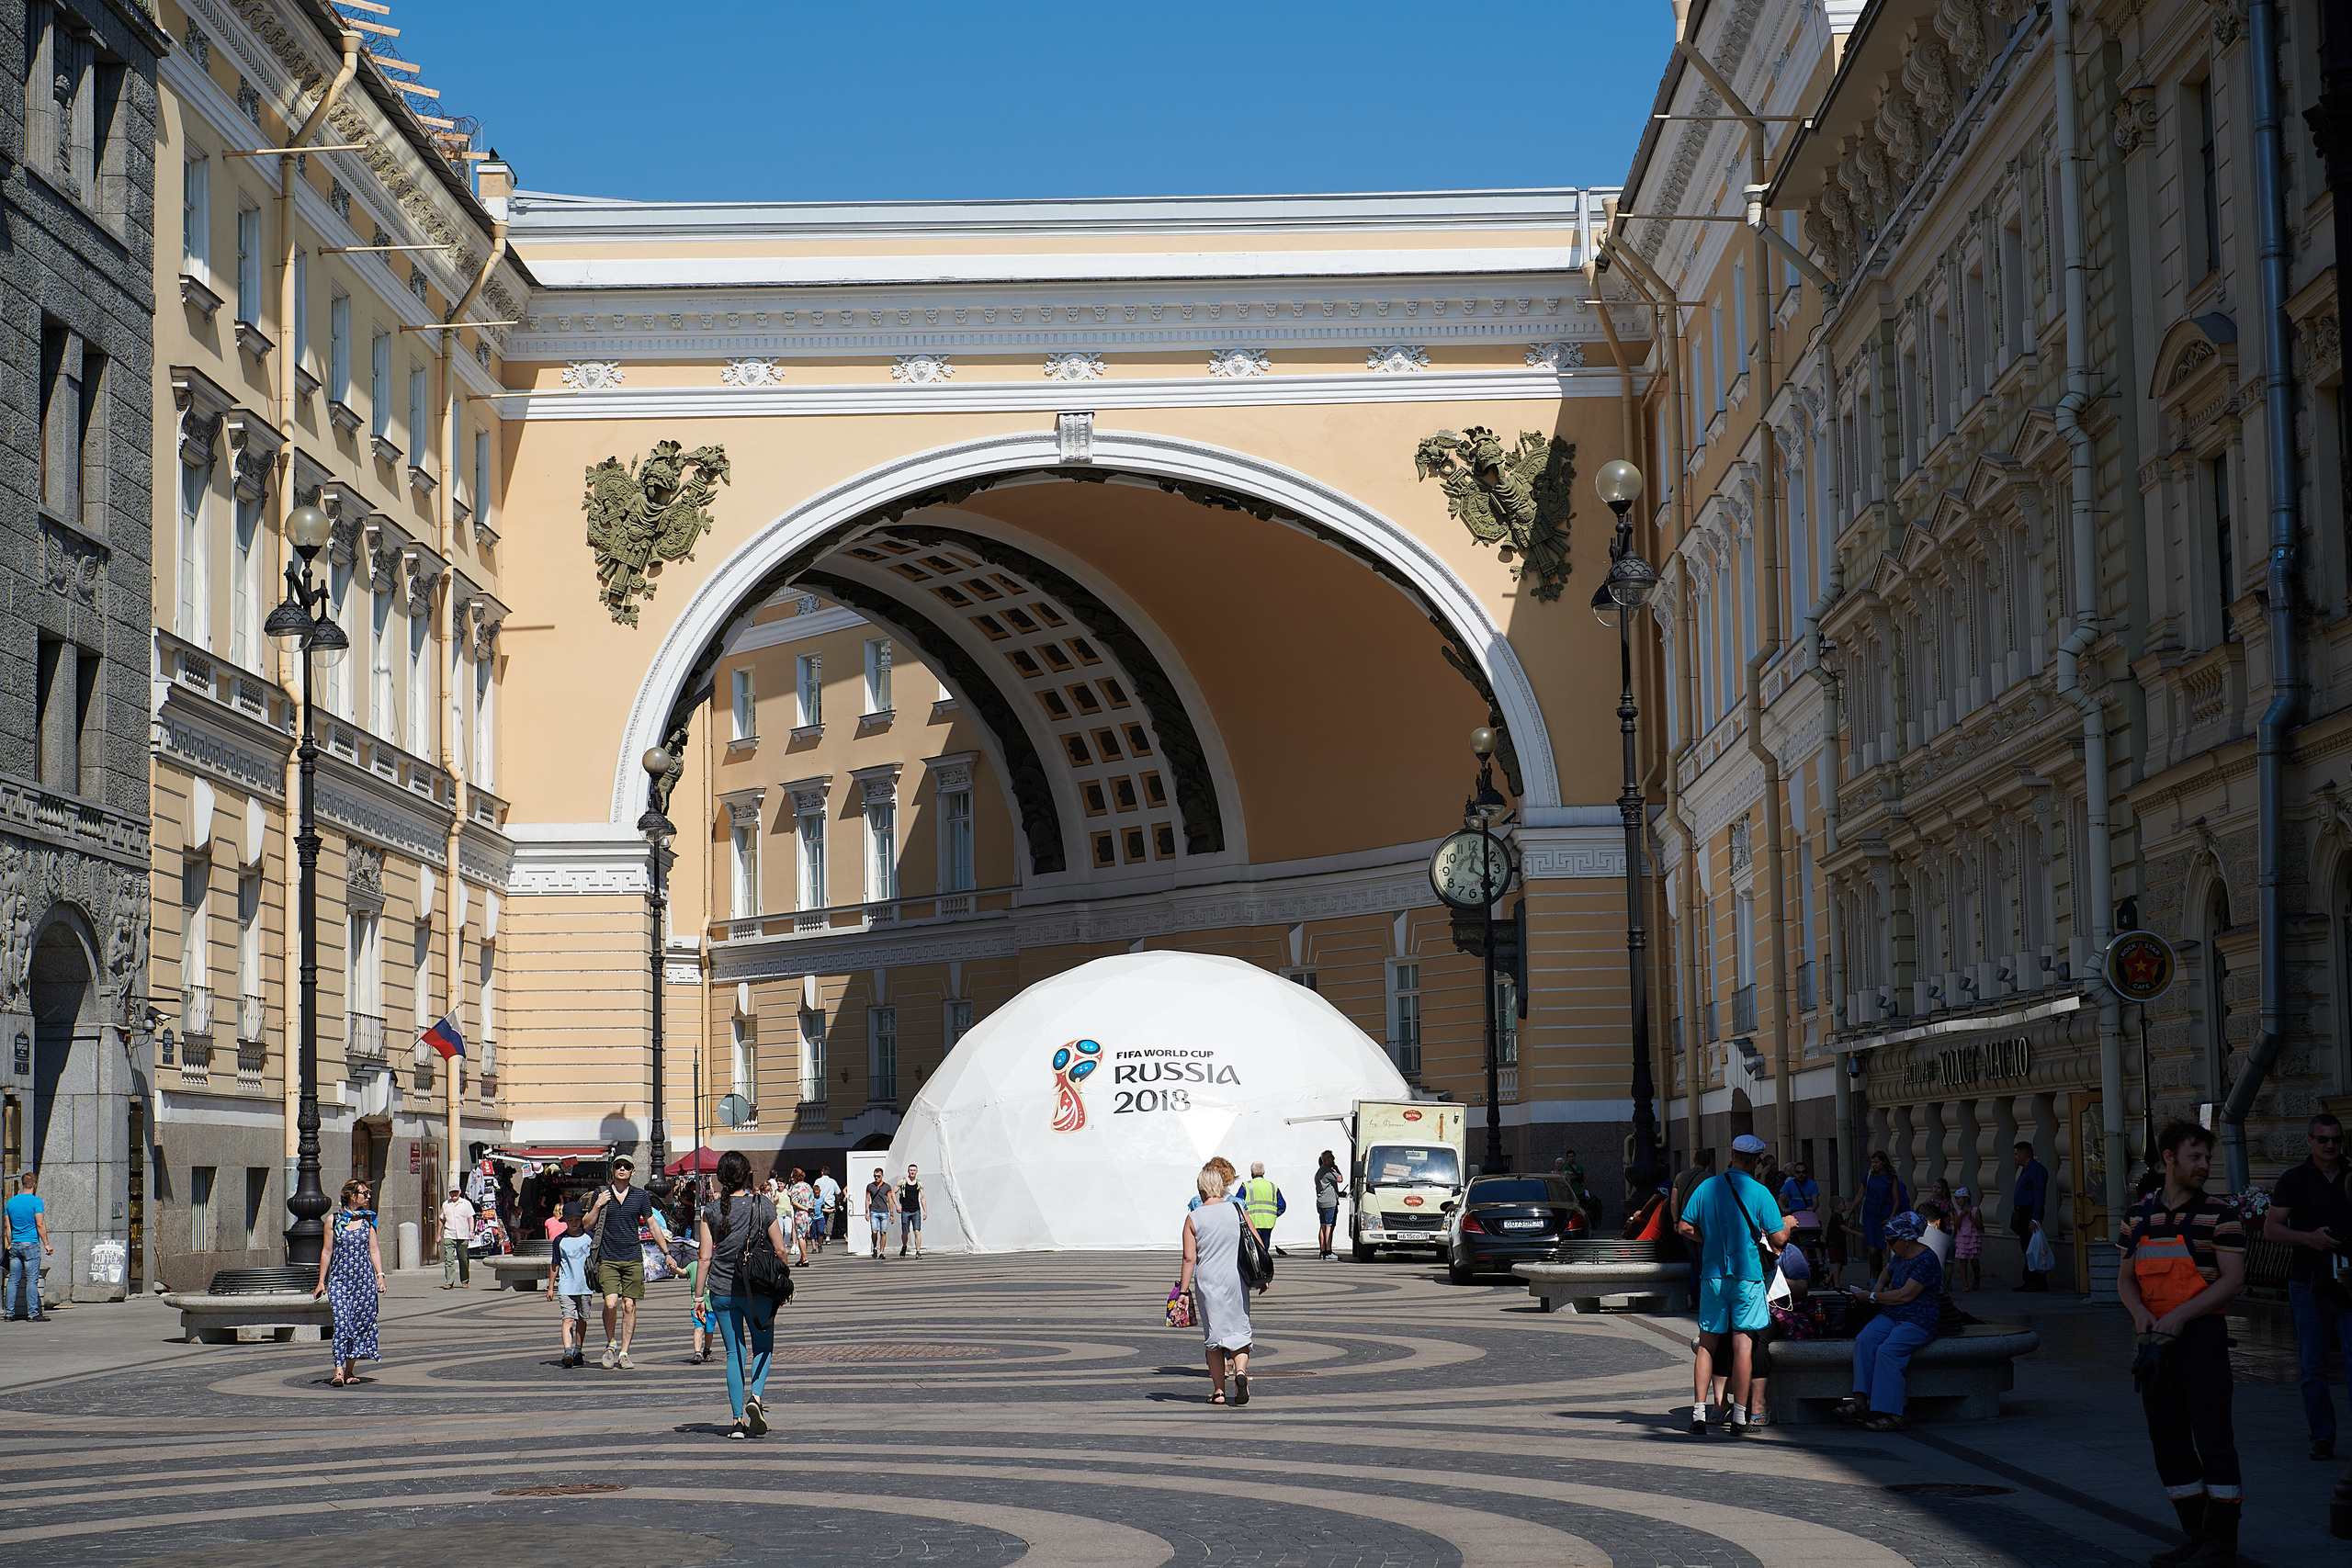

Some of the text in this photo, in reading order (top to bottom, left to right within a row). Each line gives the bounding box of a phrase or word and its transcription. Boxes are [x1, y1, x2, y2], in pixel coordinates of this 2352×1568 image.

[1457, 844, 1464, 853] 11
[1468, 840, 1477, 851] 12
[1446, 853, 1456, 863] 10
[1489, 852, 1496, 862] 2
[1442, 866, 1450, 875] 9
[1494, 863, 1500, 874] 3
[1447, 878, 1454, 888] 8
[1458, 886, 1465, 896] 7
[1469, 889, 1476, 898] 6
[2121, 915, 2127, 923] 4
[2120, 942, 2160, 957] ROCK STAR
[1116, 1049, 1215, 1059] FIFA WORLD CUP
[1902, 1037, 2029, 1085] РЕСТОРАН ХОЛСТ МАСЛО
[1114, 1062, 1241, 1086] RUSSIA
[1114, 1089, 1192, 1114] 2018
[99, 1264, 107, 1272] go
